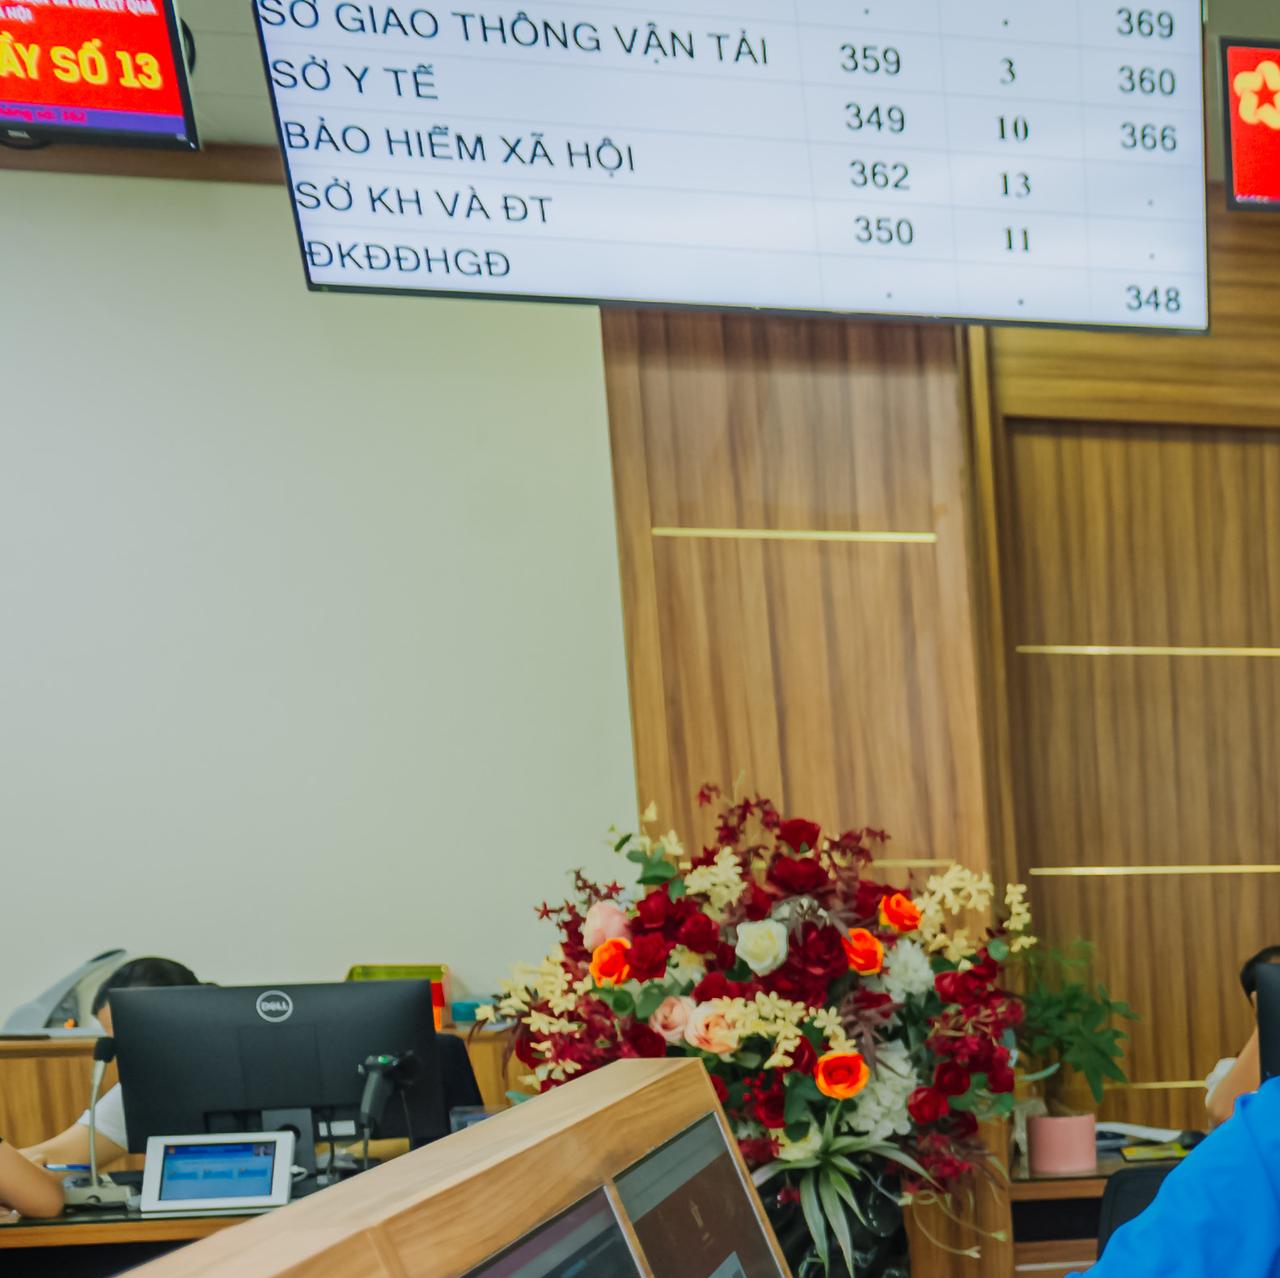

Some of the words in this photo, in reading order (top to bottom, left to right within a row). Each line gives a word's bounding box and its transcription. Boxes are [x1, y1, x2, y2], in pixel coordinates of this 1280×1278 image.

[335, 3, 438, 38] GIAO
[451, 11, 600, 51] THÔNG
[614, 22, 694, 63] VẬN
[707, 29, 768, 64] TẢI
[839, 43, 901, 76] 359
[1000, 57, 1017, 85] 3
[1118, 65, 1176, 96] 360
[1116, 7, 1175, 39] 369
[50, 38, 109, 85] SỐ
[116, 51, 163, 90] 13
[272, 55, 330, 91] SỞ
[344, 64, 369, 94] Y
[844, 102, 905, 133] 349
[997, 115, 1029, 141] 10
[1120, 122, 1177, 152] 366
[283, 116, 370, 153] BẢO
[500, 131, 554, 166] XÃ
[567, 137, 635, 177] HỘI
[850, 160, 911, 191] 362
[1000, 172, 1031, 198] 13
[295, 177, 353, 211] SỞ
[368, 186, 423, 215] KH
[436, 186, 490, 220] VÀ
[502, 194, 553, 223] ĐT
[854, 216, 914, 246] 350
[1004, 228, 1030, 252] 11
[305, 241, 511, 277] ĐKĐĐHGĐ
[1125, 286, 1181, 312] 348
